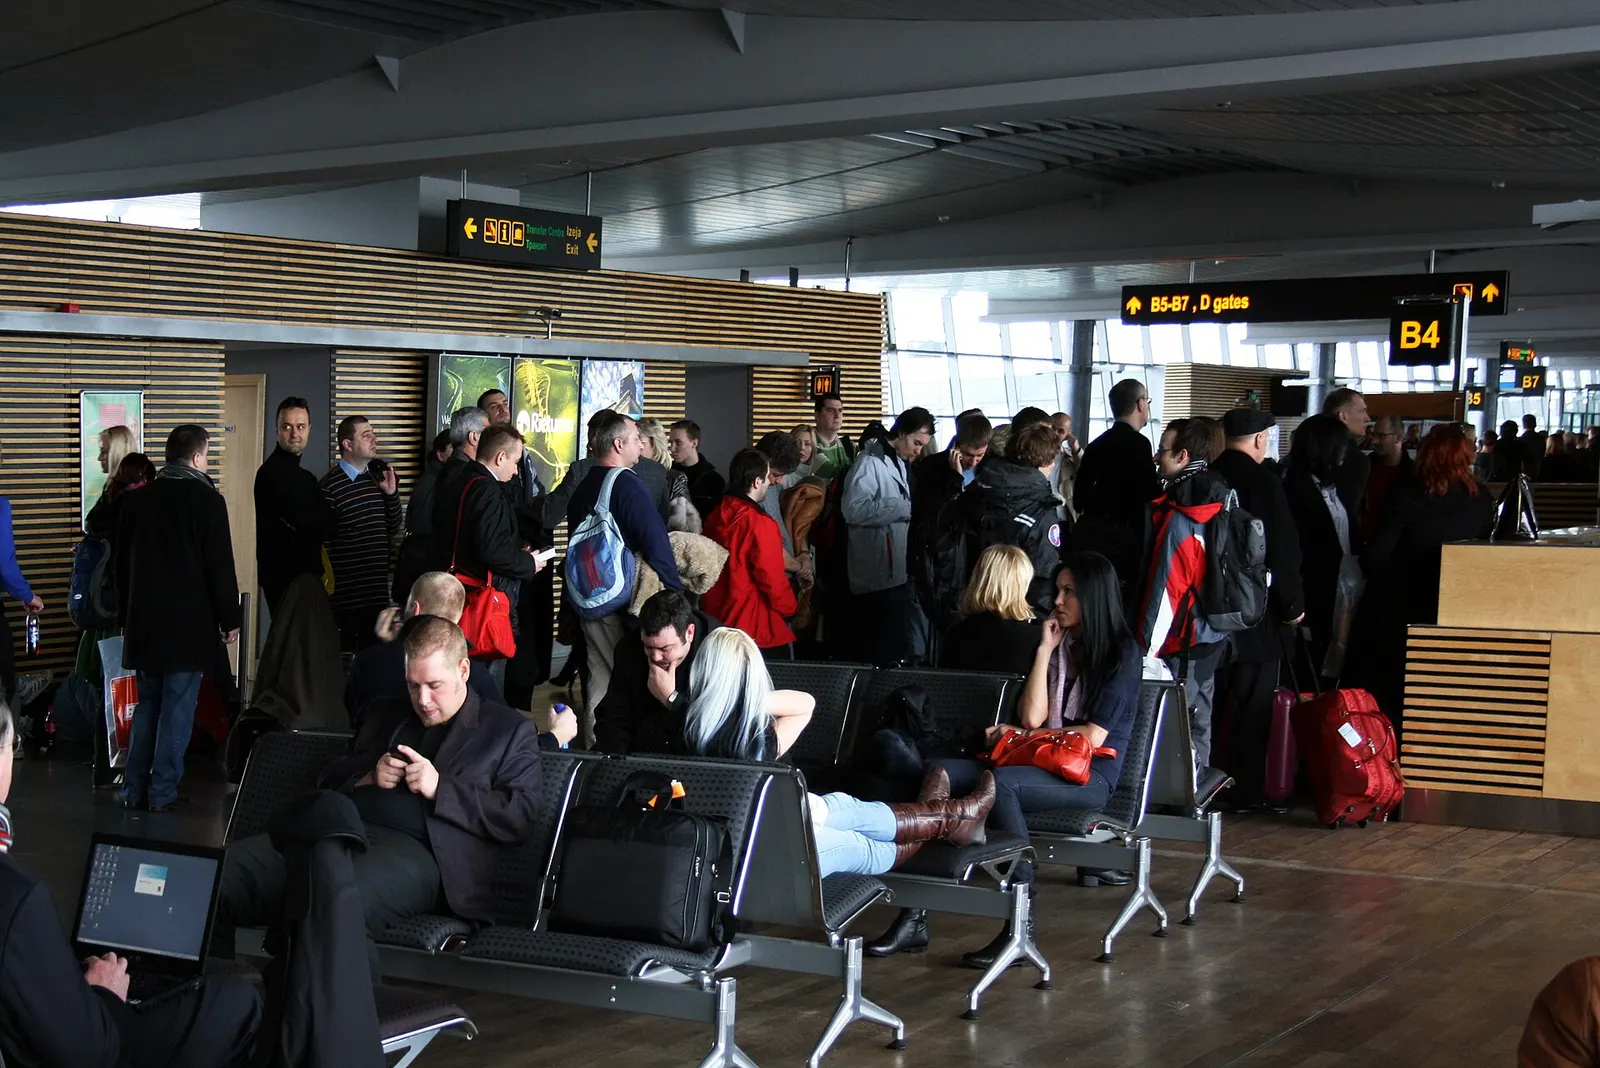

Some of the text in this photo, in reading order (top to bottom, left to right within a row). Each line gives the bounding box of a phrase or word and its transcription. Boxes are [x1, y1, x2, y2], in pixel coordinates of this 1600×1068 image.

[566, 225, 582, 239] Izeja
[566, 243, 579, 255] Exit
[1150, 295, 1190, 312] B5-B7
[1200, 294, 1211, 310] D
[1213, 294, 1249, 313] gates
[1399, 319, 1441, 349] B4
[1522, 375, 1540, 389] B7
